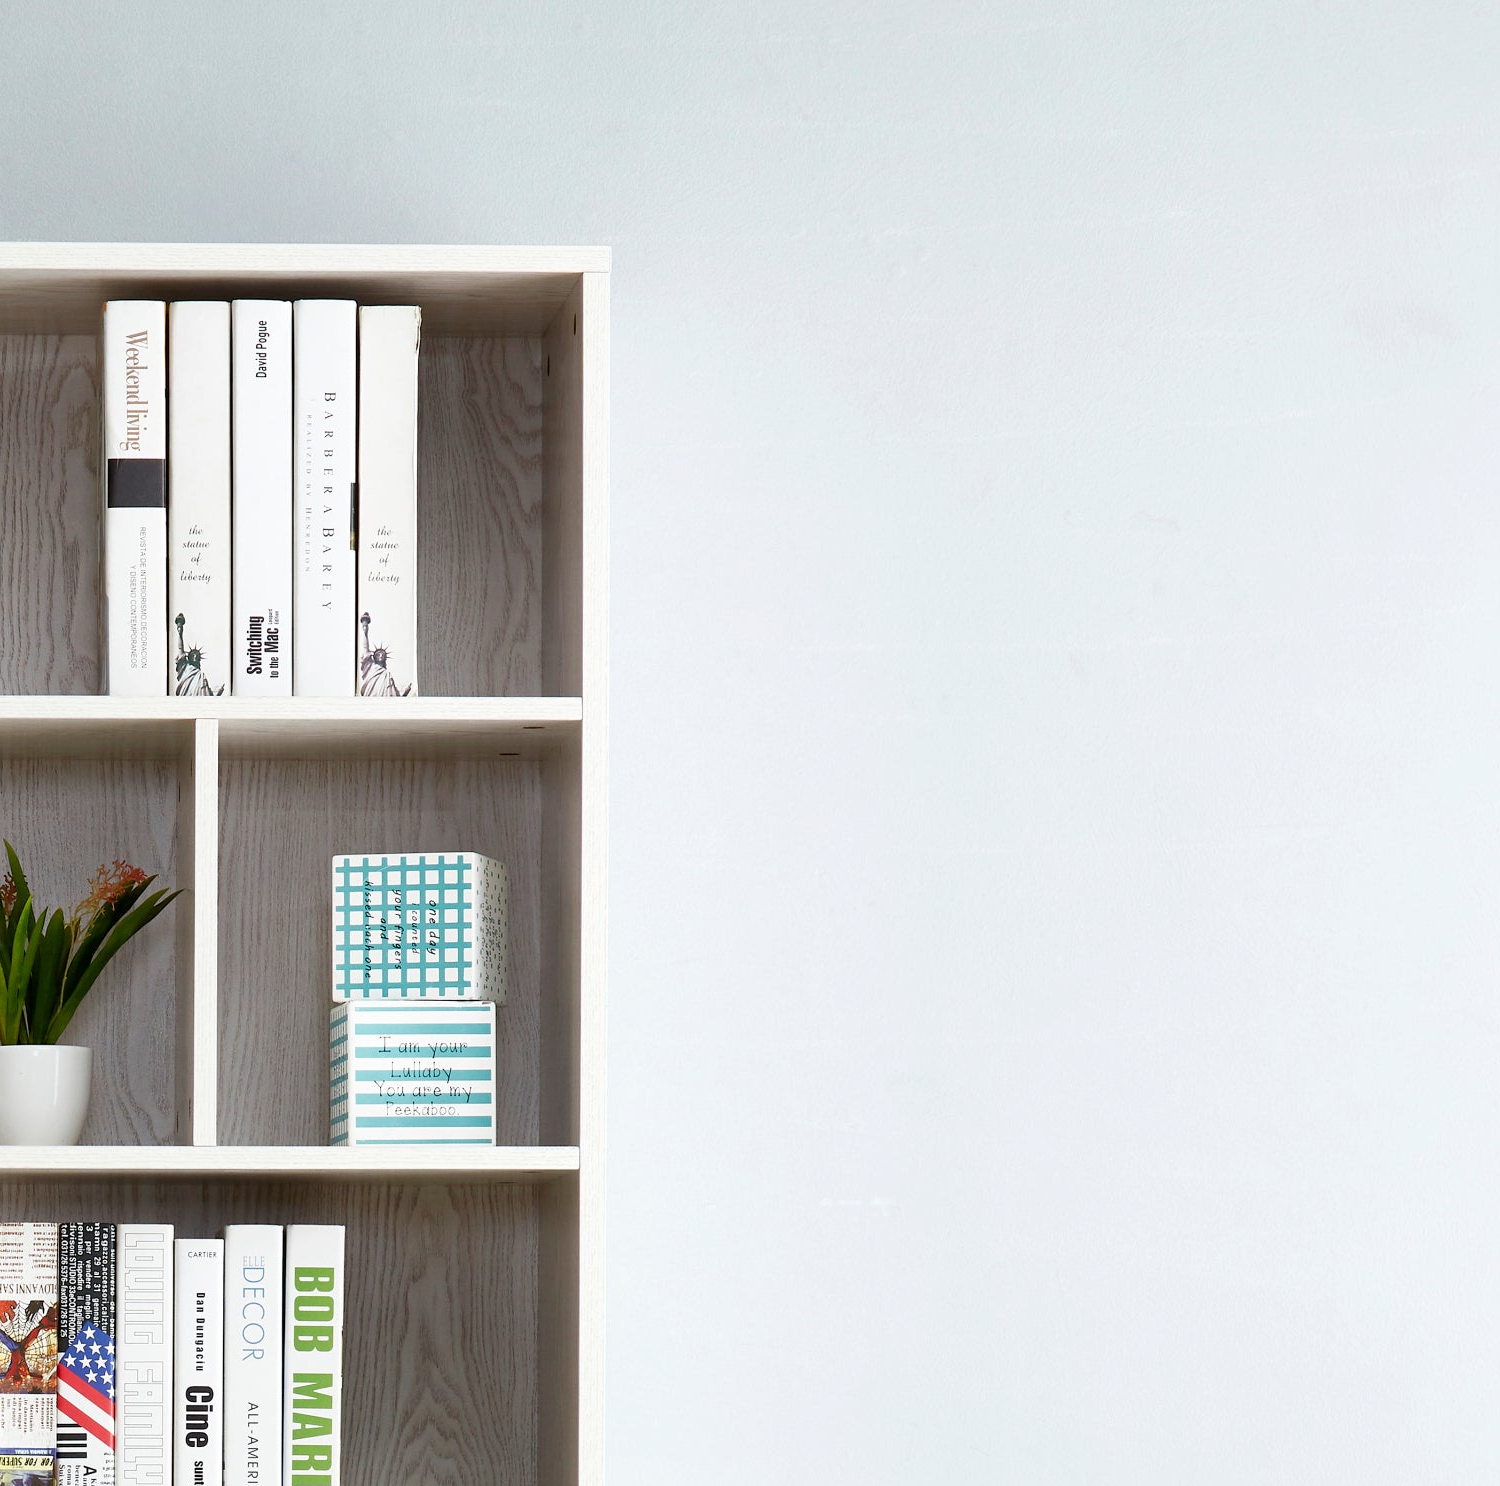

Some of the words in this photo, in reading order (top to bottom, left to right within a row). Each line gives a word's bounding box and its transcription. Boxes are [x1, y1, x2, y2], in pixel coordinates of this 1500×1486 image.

[256, 321, 270, 349] Pogue
[125, 330, 148, 405] Weekend
[255, 353, 267, 378] David
[120, 409, 148, 451] living
[189, 525, 203, 534] the
[377, 525, 392, 536] the
[191, 552, 202, 566] of
[379, 553, 389, 567] of
[181, 570, 211, 584] liberty
[368, 572, 400, 585] liberty
[246, 616, 264, 674] Switching
[264, 628, 279, 653] Mac
[269, 657, 279, 668] the
[365, 880, 374, 919] kissed
[392, 889, 402, 919] your
[429, 900, 437, 924] one
[365, 924, 374, 951] each
[380, 918, 388, 940] and
[392, 925, 404, 970] fingers
[427, 931, 440, 955] day
[378, 1036, 391, 1053] I
[398, 1042, 420, 1053] am
[428, 1042, 468, 1059] your
[391, 1061, 452, 1084] Lullaby
[374, 1080, 406, 1097] You
[412, 1086, 442, 1097] are
[449, 1086, 472, 1103] my
[84, 1241, 92, 1254] per
[94, 1257, 101, 1266] 29
[243, 1256, 265, 1266] ELLE
[76, 1260, 84, 1290] rispedire
[94, 1284, 101, 1292] 31
[84, 1295, 92, 1319] meglio
[196, 1292, 206, 1313] Dan
[293, 1266, 335, 1353] BOB
[242, 1268, 265, 1361] DECOR
[194, 1318, 206, 1372] Dungaciu
[185, 1385, 215, 1448] Cine
[24, 1458, 37, 1466] FOR
[83, 1465, 97, 1476] A
